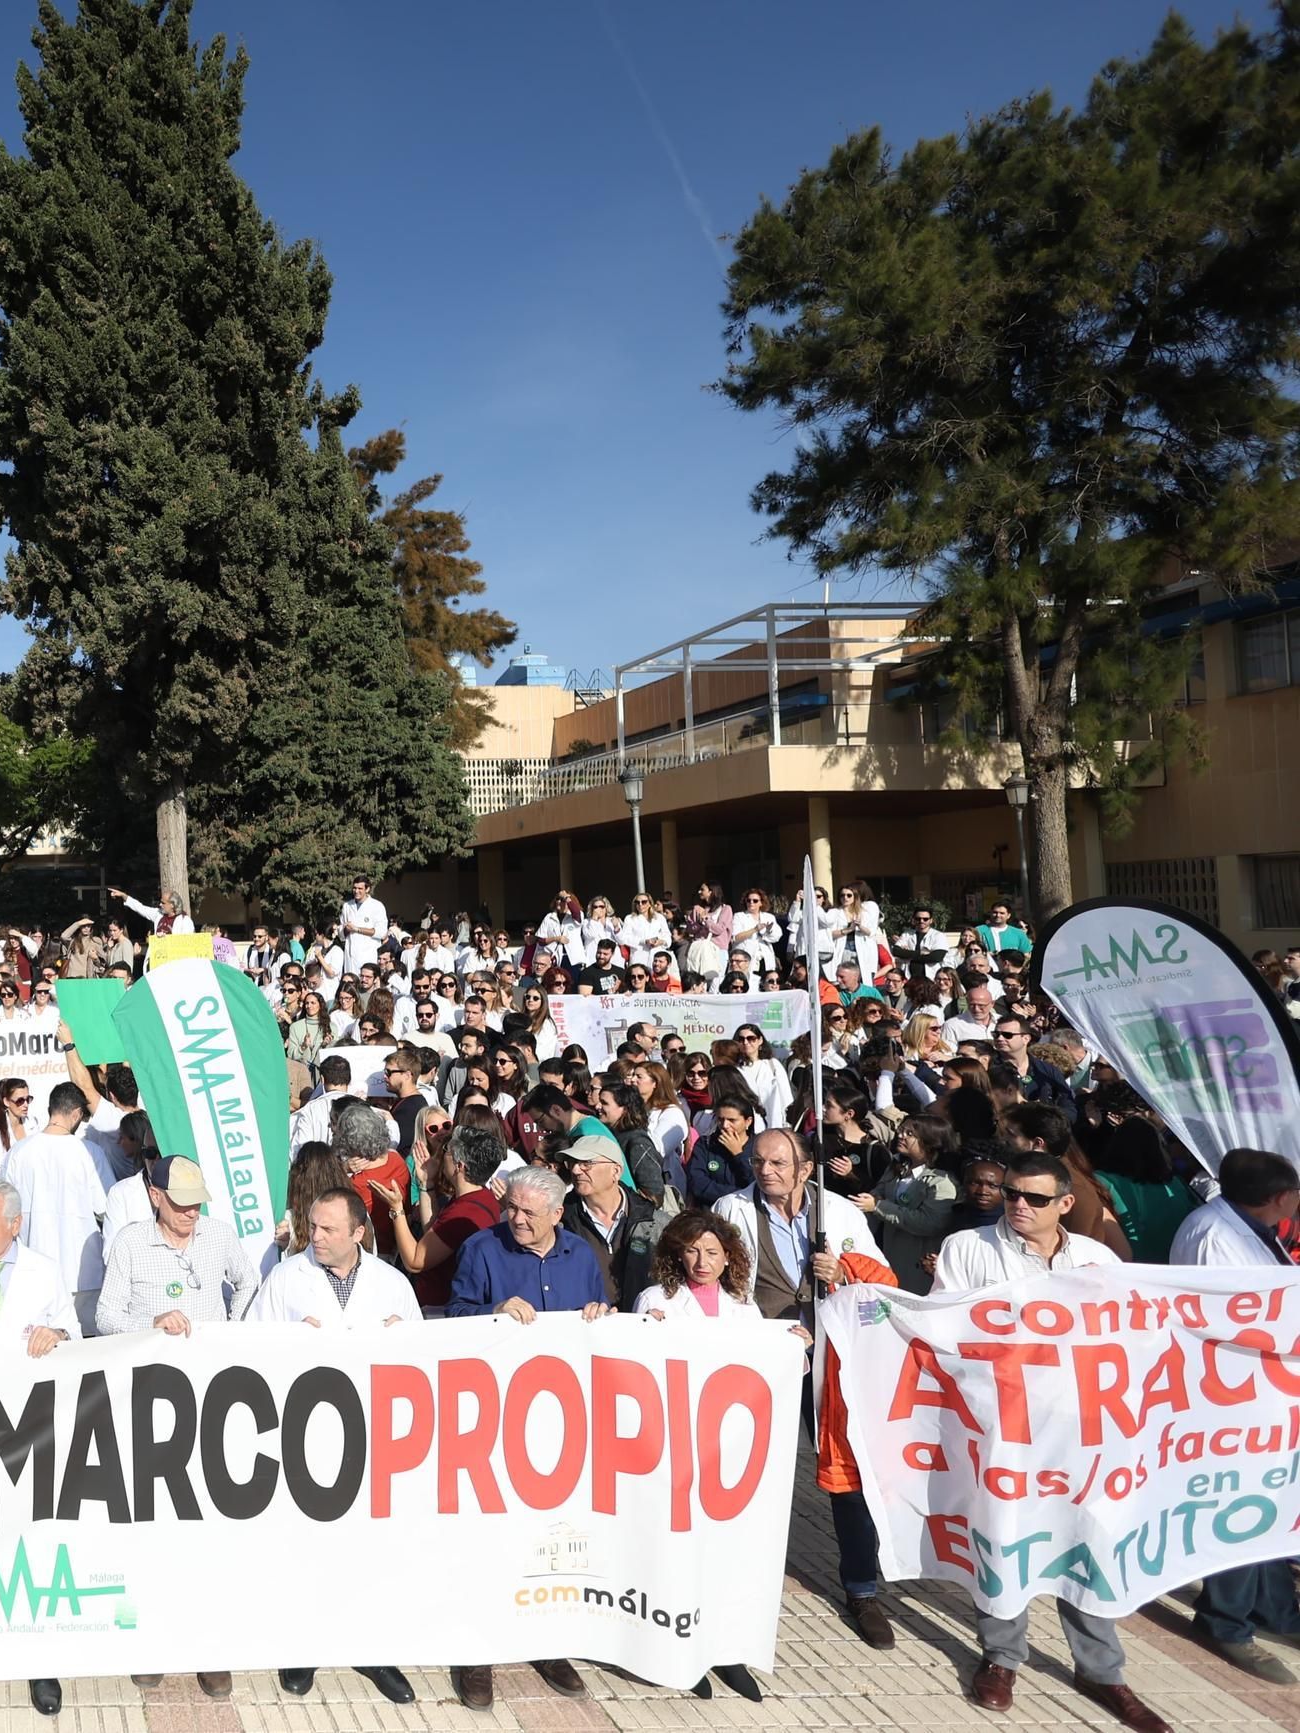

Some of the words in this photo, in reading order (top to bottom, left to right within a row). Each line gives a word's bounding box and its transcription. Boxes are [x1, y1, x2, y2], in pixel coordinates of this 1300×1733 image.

[600, 996, 614, 1009] KIT
[19, 1059, 68, 1076] médico
[174, 995, 235, 1095] SMA
[216, 1097, 265, 1236] Málaga
[969, 1288, 1209, 1336] contra
[1226, 1287, 1286, 1325] el
[902, 1441, 950, 1472] a
[967, 1438, 1148, 1505] las/os
[1187, 1468, 1240, 1498] en
[925, 1494, 1278, 1601] ESTATUTO
[6, 1621, 45, 1635] Andaluz
